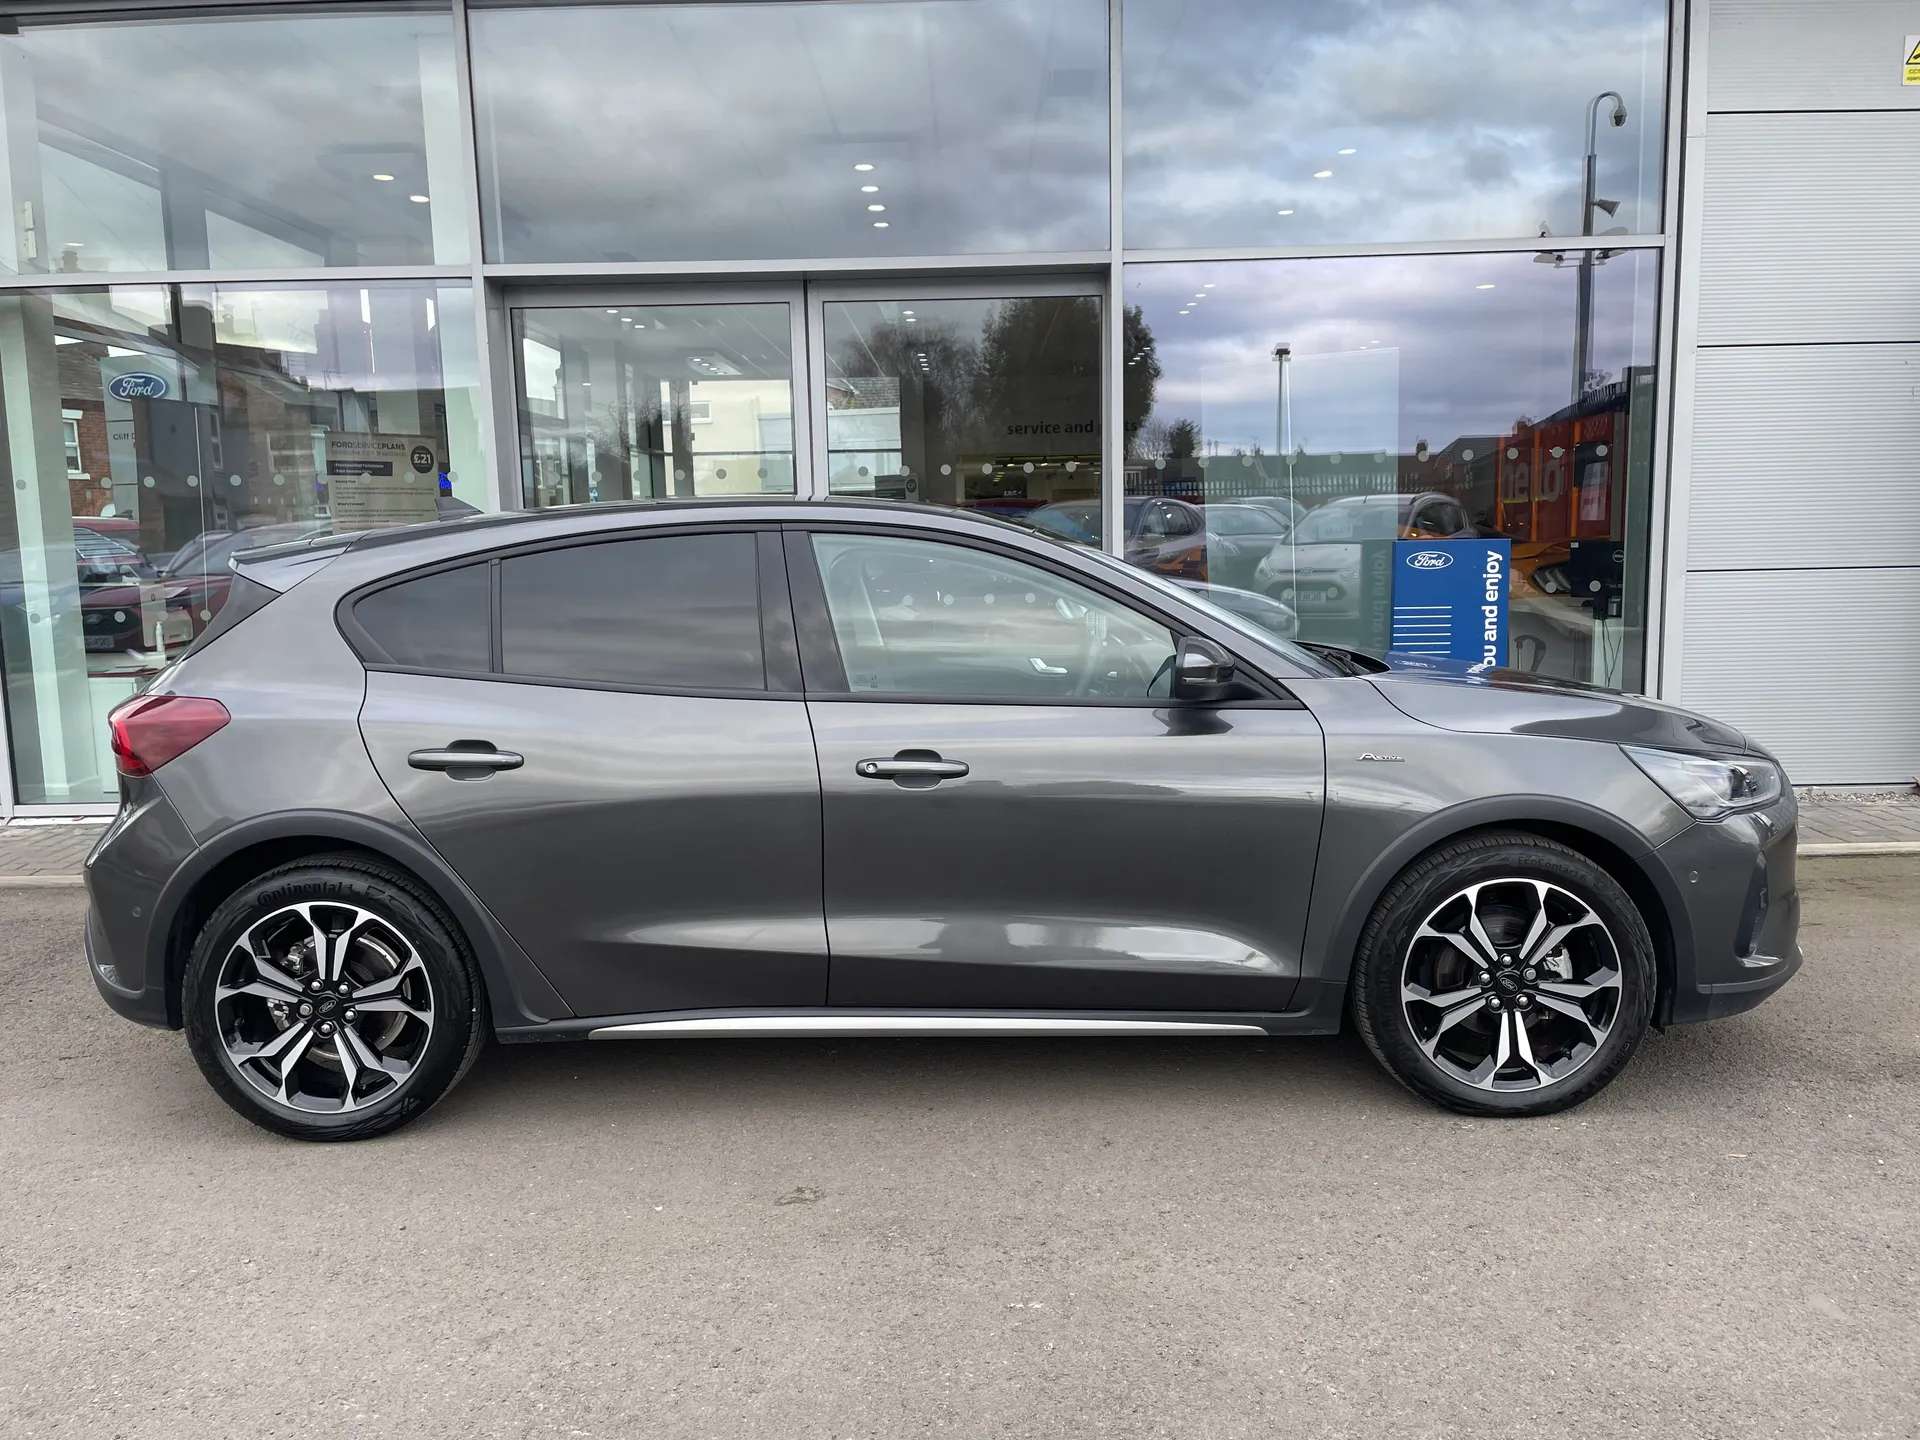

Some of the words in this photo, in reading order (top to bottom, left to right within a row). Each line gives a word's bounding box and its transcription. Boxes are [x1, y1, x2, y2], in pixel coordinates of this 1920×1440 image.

[119, 377, 154, 397] Ford
[1007, 420, 1061, 435] service
[1064, 420, 1094, 434] and
[413, 453, 432, 464] £21
[1414, 553, 1445, 567] Ford
[1482, 550, 1503, 602] enjoy
[1481, 605, 1498, 642] and
[1483, 645, 1497, 667] ou
